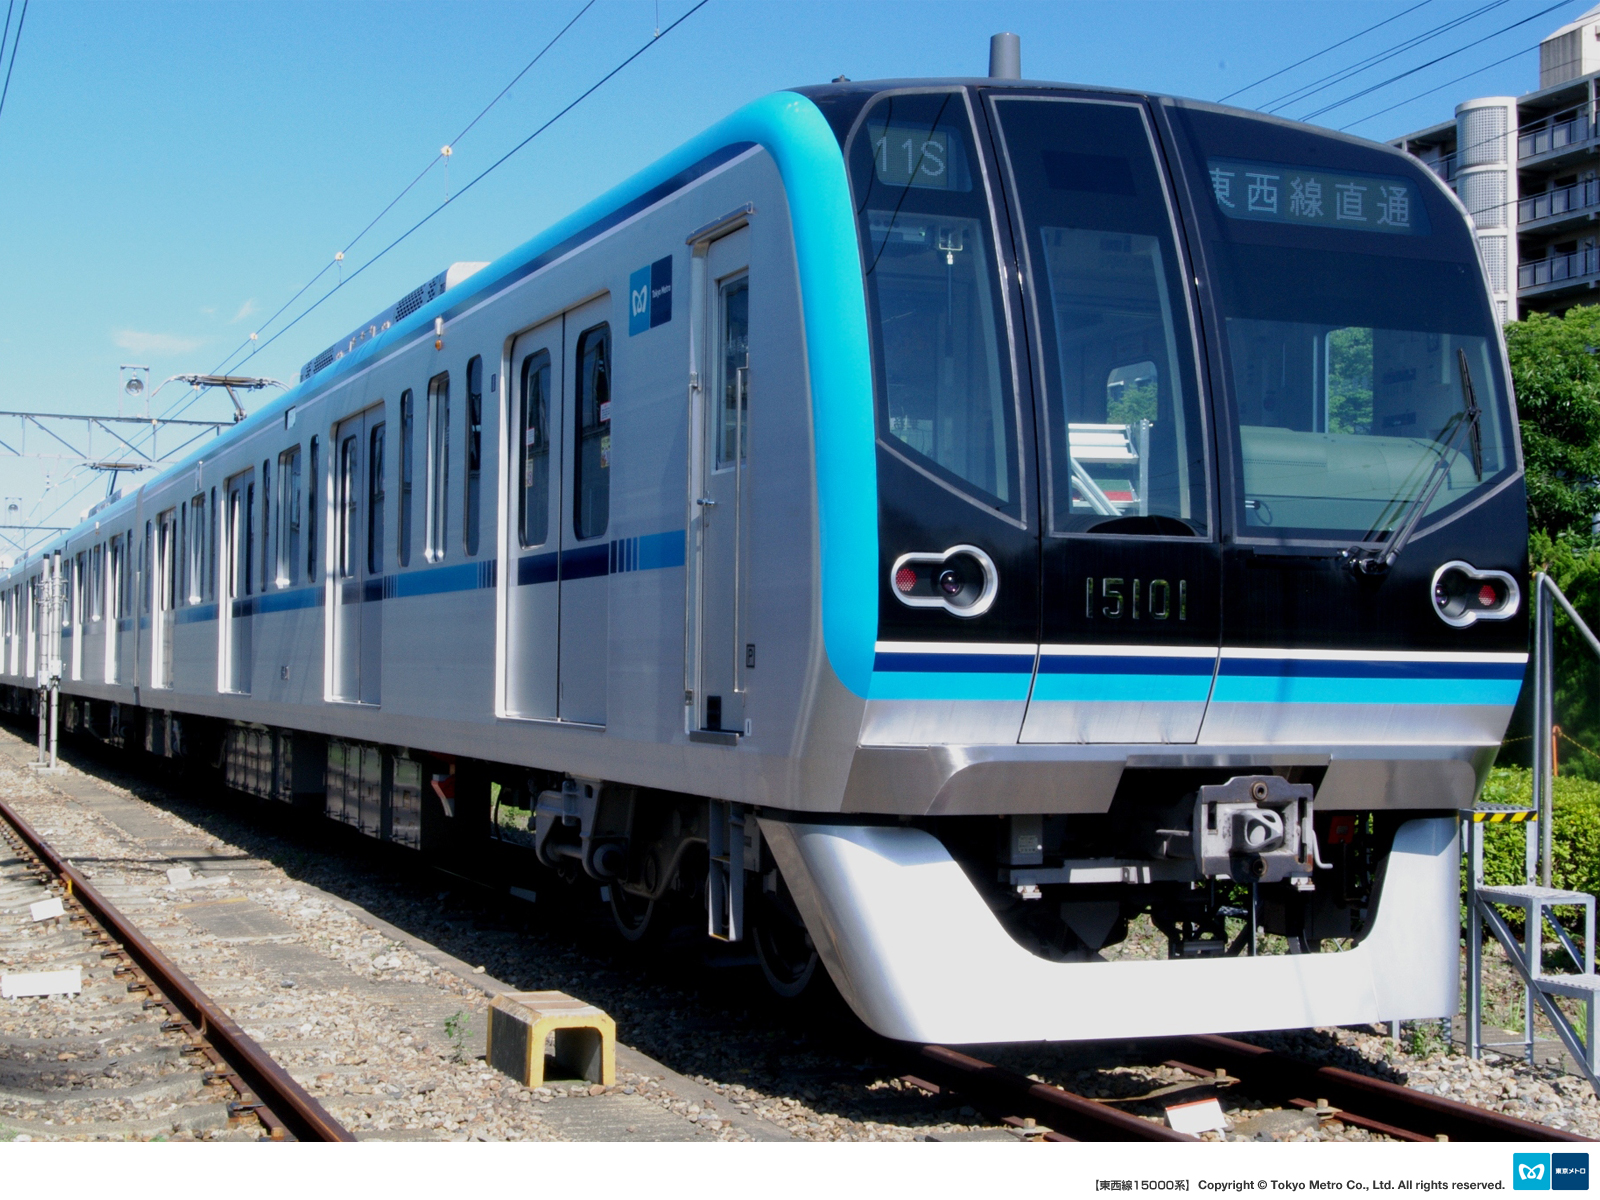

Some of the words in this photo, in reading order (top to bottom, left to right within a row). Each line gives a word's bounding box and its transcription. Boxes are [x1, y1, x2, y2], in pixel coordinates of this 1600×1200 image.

[876, 136, 946, 176] 11S
[1209, 168, 1410, 228] 東西線直通
[1086, 577, 1187, 620] 15101
